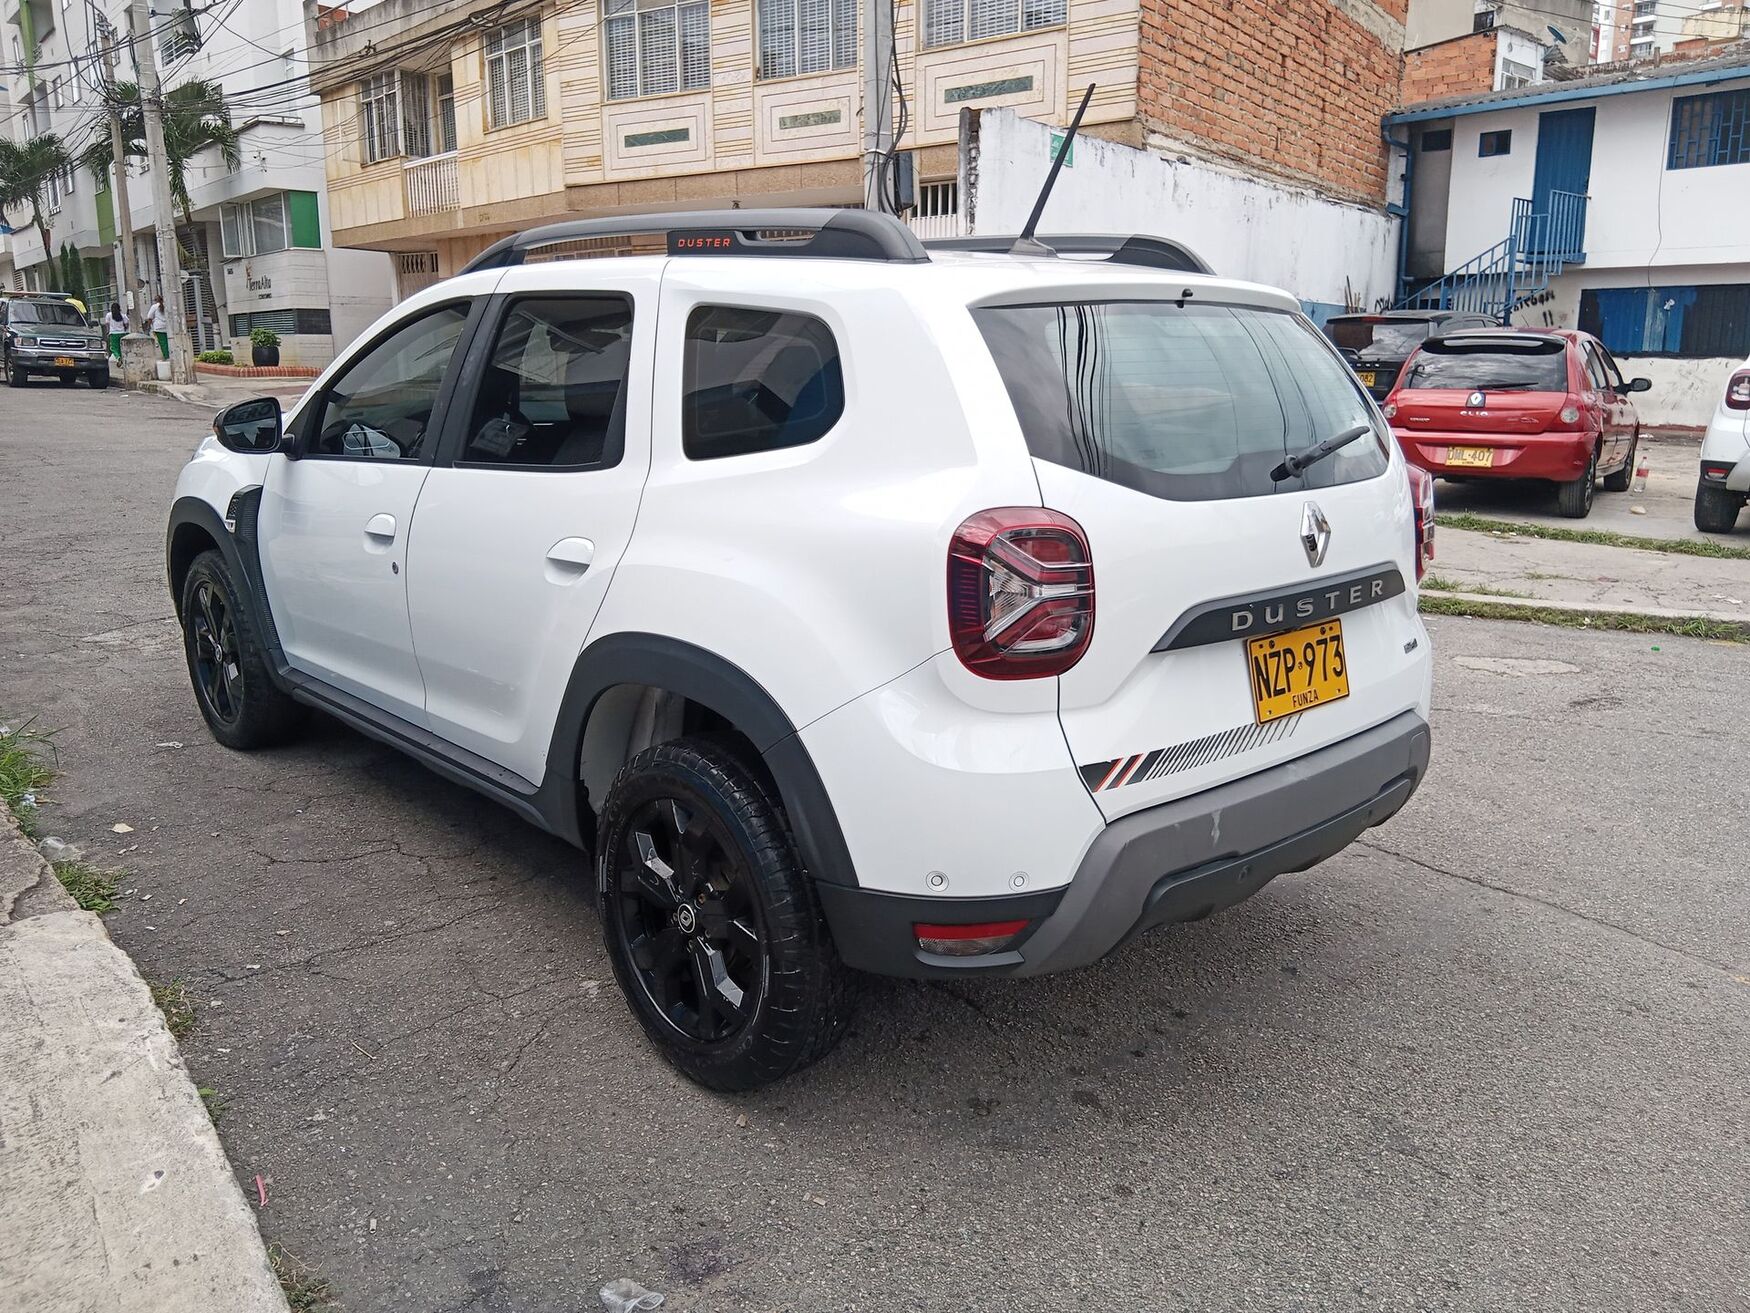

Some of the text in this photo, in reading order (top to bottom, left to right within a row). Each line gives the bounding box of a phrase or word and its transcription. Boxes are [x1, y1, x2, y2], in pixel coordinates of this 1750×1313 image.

[678, 238, 731, 248] DUSTER
[1231, 579, 1384, 631] DUSTER
[1292, 688, 1319, 708] FUNZA
